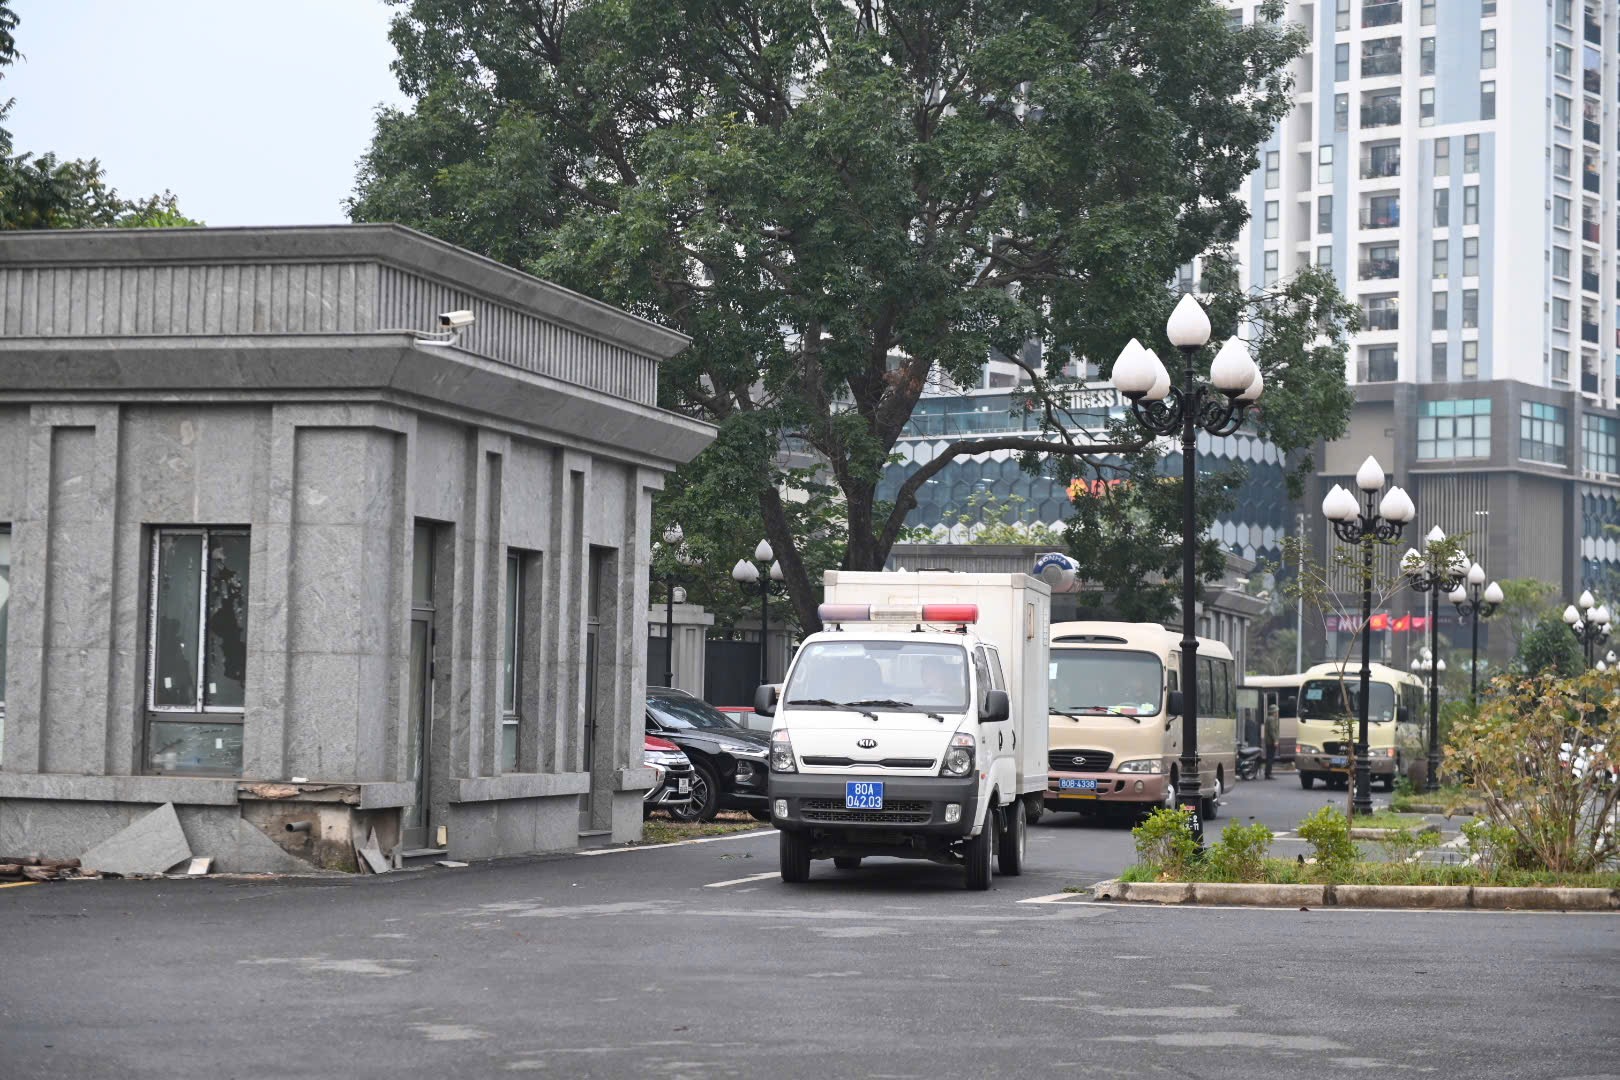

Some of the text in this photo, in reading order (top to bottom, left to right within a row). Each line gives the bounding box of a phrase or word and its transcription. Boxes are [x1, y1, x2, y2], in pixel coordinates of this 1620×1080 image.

[858, 738, 876, 748] KIA
[855, 783, 874, 796] 80A
[847, 795, 881, 808] 042.03
